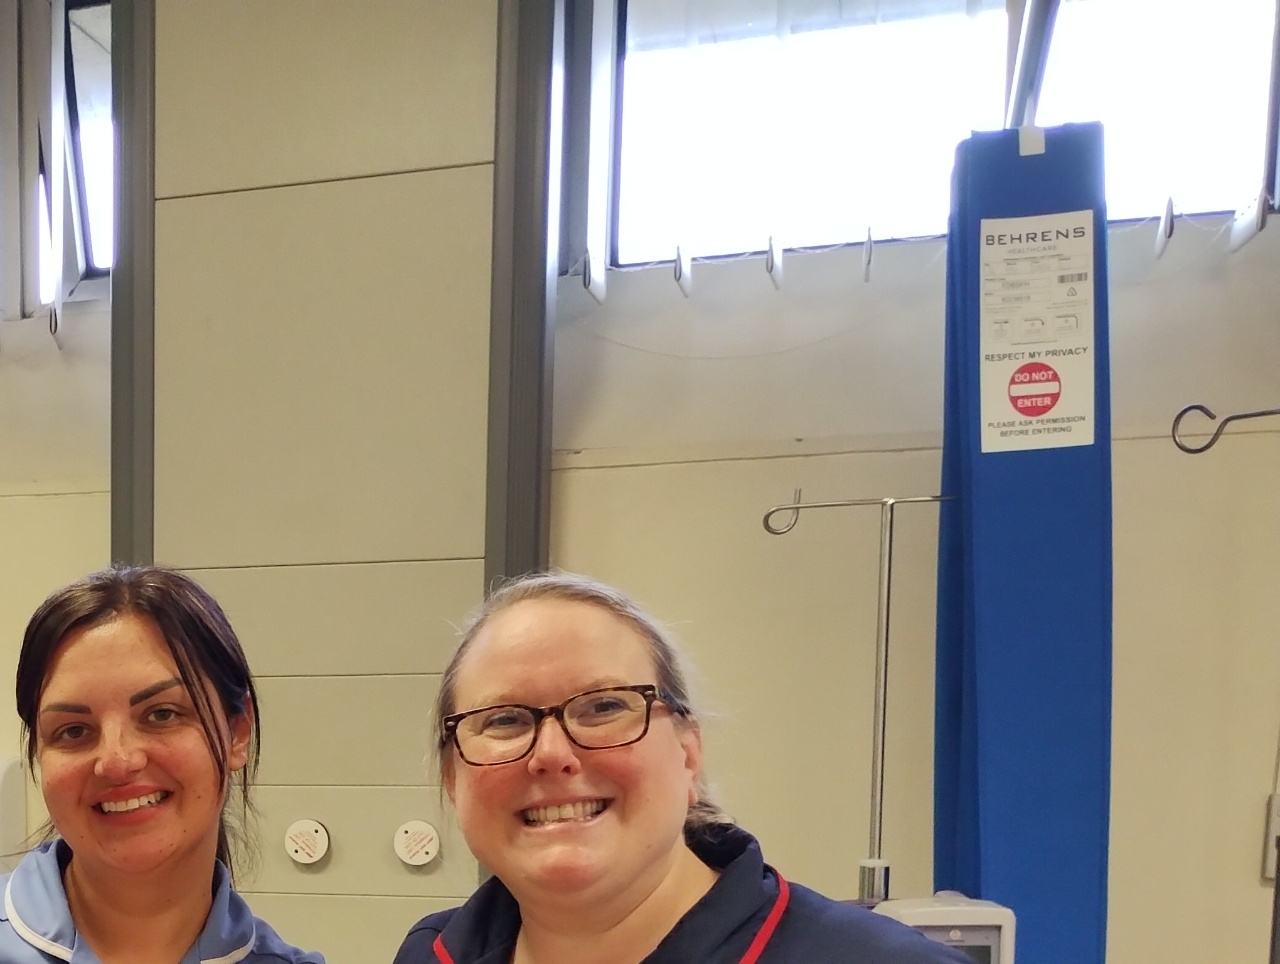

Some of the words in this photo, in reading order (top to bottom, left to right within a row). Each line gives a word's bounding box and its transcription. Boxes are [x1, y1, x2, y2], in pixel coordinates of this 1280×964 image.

[985, 226, 1086, 246] BEHRENS
[1007, 244, 1058, 255] HEALTHCARE
[984, 351, 1026, 362] RESPECT
[1028, 350, 1042, 360] MY
[1045, 346, 1089, 358] PRIVACY
[1014, 372, 1030, 383] DO
[1031, 370, 1054, 381] NOT
[1016, 396, 1052, 408] ENTER
[987, 420, 1016, 429] PLEASE
[1018, 419, 1033, 427] ASK
[1035, 415, 1086, 426] PERMISSION
[999, 428, 1030, 438] BEFORE
[1031, 425, 1072, 436] ENTERING
